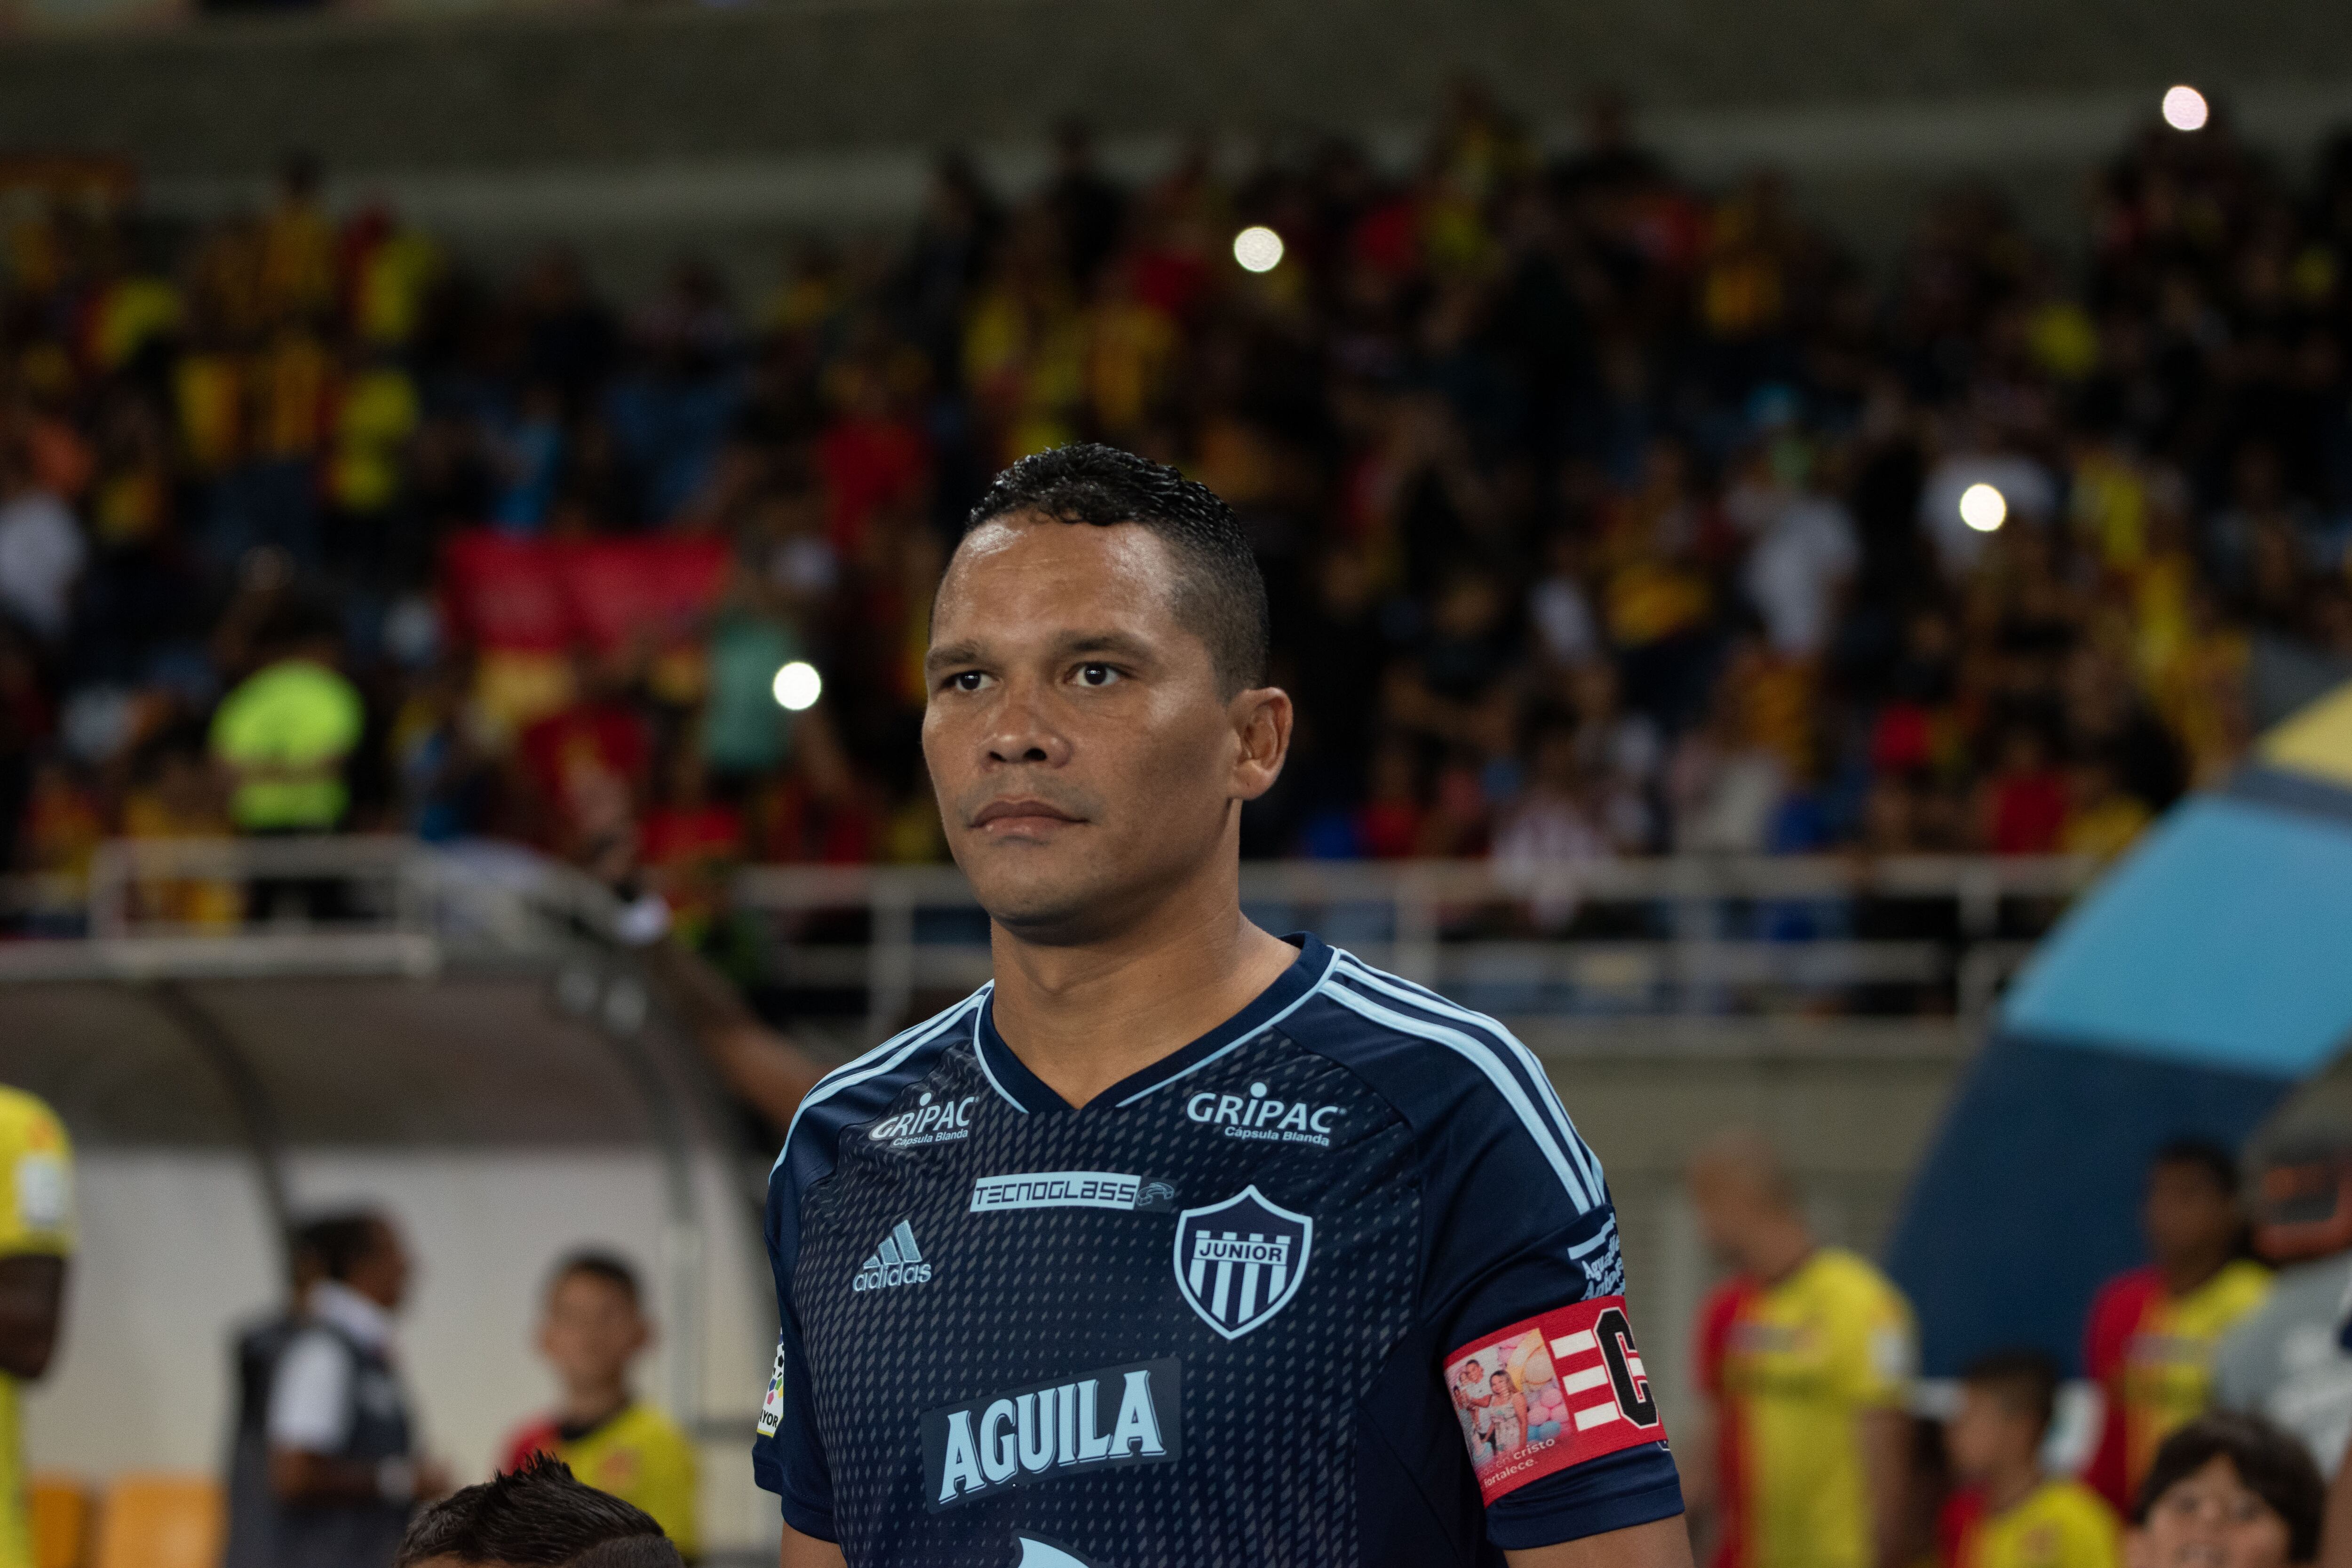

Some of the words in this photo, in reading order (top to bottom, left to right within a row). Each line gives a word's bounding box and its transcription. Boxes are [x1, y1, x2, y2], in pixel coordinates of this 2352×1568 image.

[893, 1134, 933, 1146] Cápsula
[935, 1129, 969, 1142] Blanda
[1224, 1126, 1279, 1140] Cápsula
[1282, 1131, 1330, 1147] Blanda
[976, 1180, 1137, 1205] TECNOGLASS
[1199, 1242, 1282, 1262] JUNIOR
[852, 1262, 932, 1291] adidas
[1593, 1306, 1660, 1429] C
[938, 1369, 1167, 1504] AGUILA
[1513, 1438, 1555, 1460] cristo
